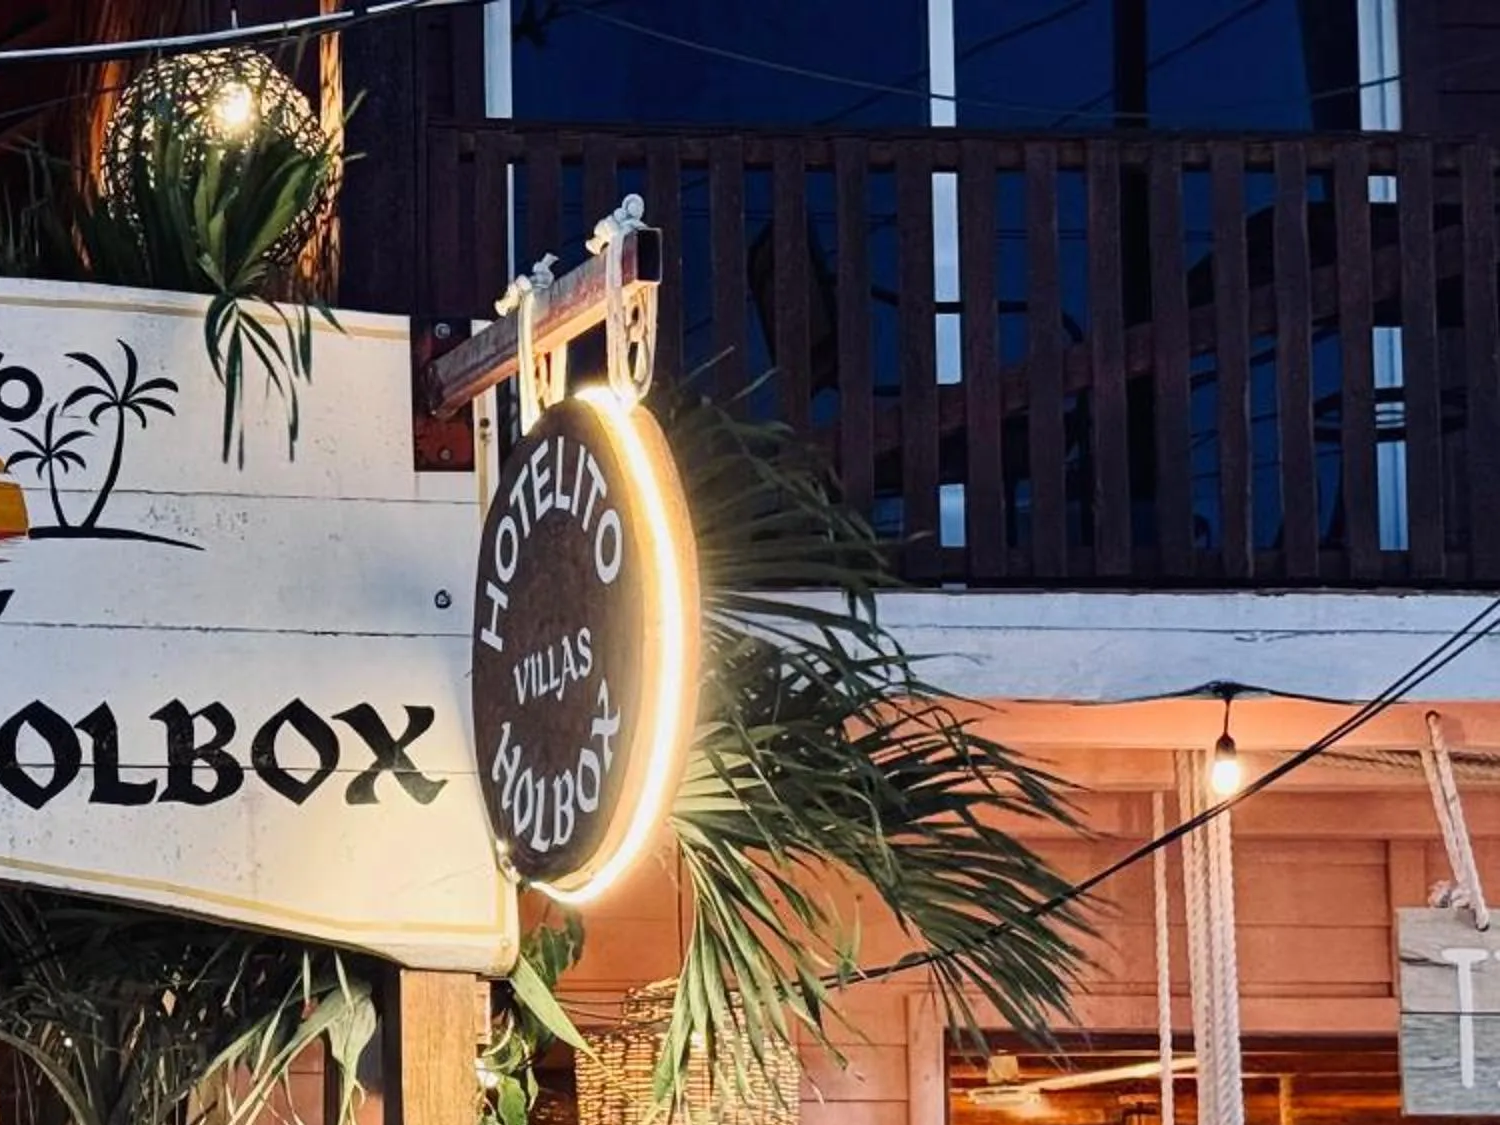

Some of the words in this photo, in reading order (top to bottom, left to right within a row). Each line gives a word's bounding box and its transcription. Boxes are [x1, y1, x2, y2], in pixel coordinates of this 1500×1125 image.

[481, 435, 622, 652] HOTELITO
[513, 627, 593, 705] VILLAS
[491, 678, 621, 852] HOLBOX
